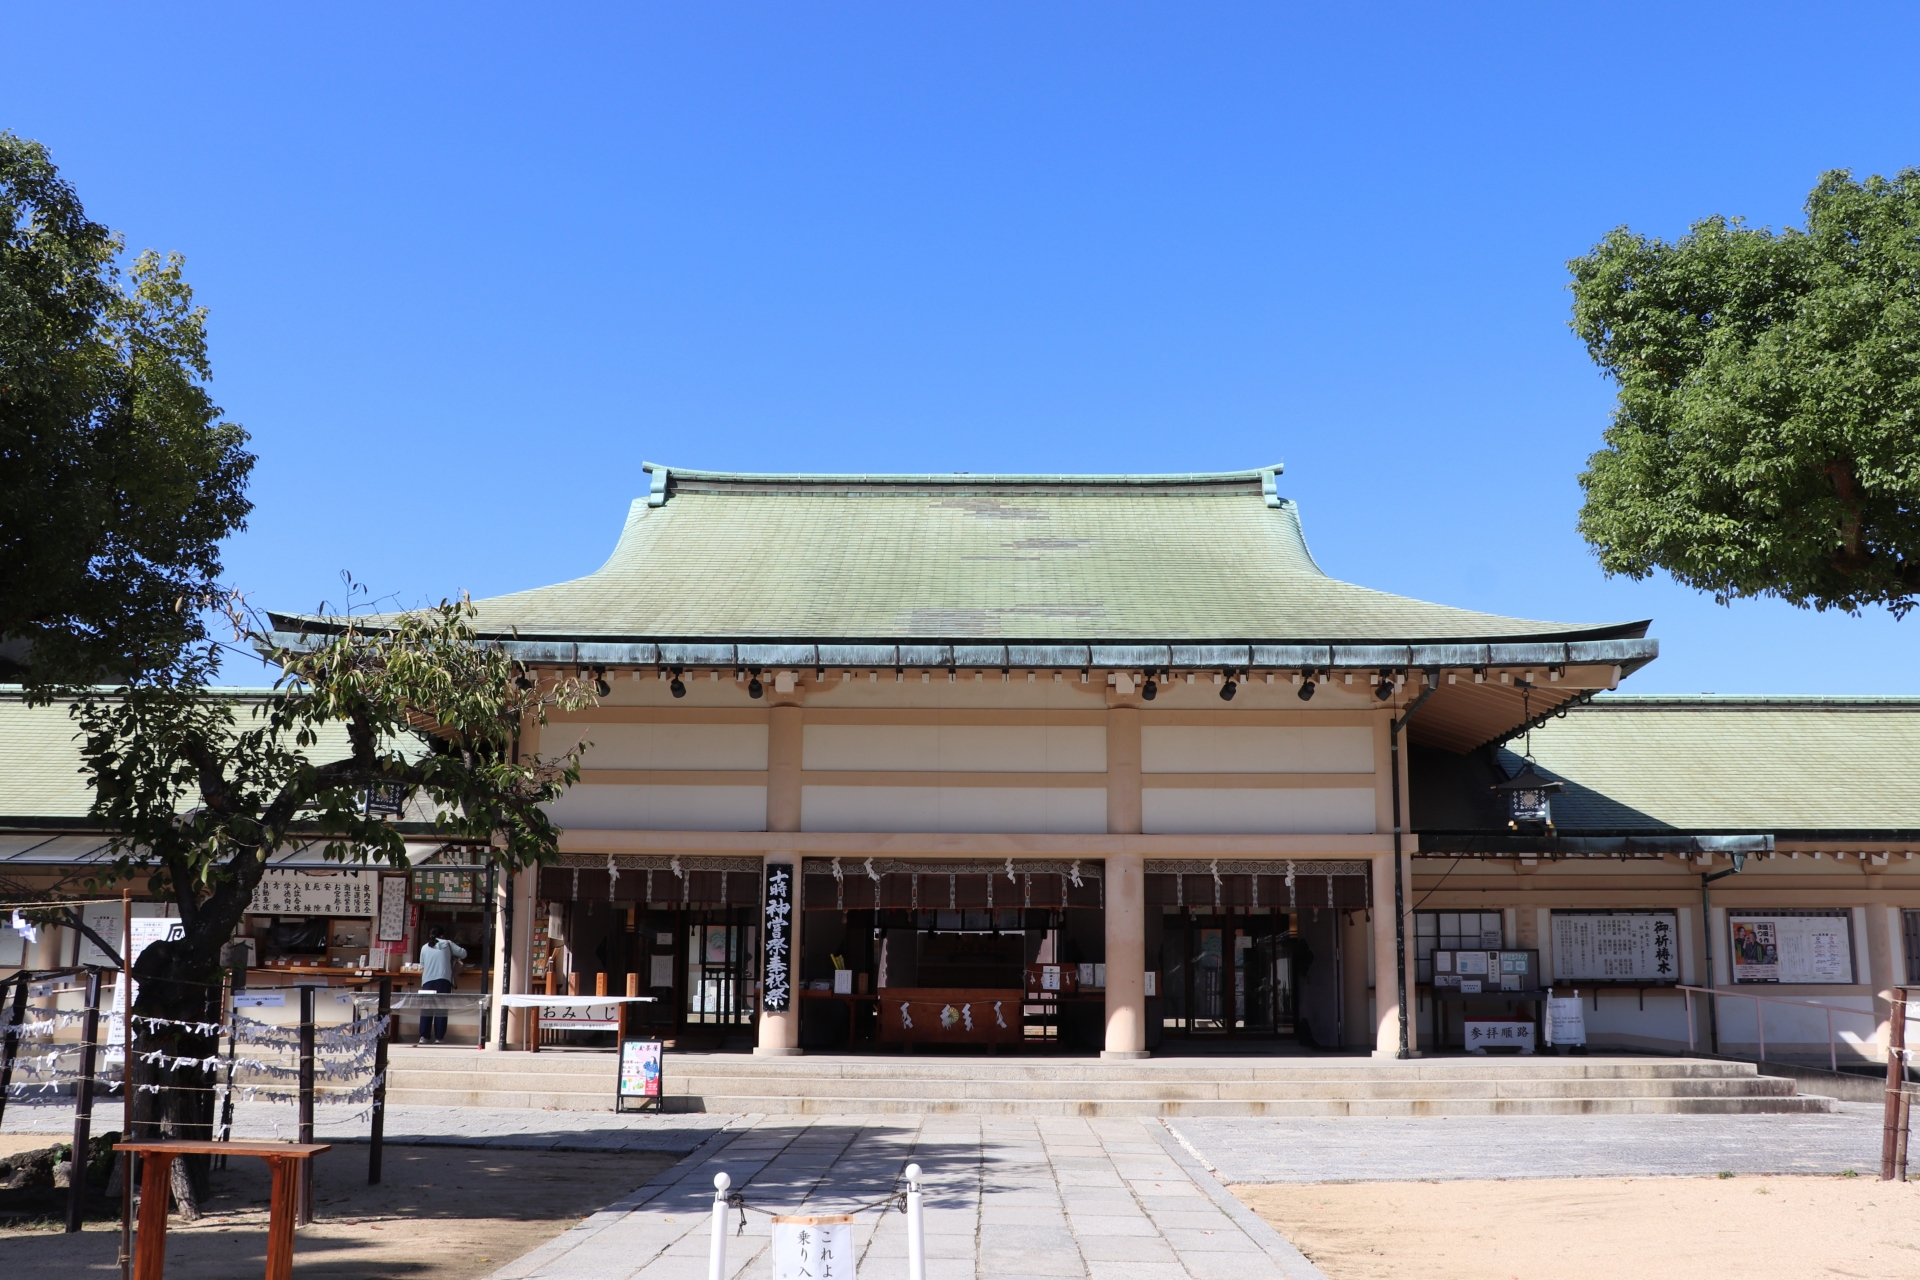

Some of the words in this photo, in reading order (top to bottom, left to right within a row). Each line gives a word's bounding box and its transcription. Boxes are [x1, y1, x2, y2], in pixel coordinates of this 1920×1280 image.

[363, 884, 371, 914] 家内安全
[543, 1005, 615, 1020] おみくじ
[1471, 1026, 1530, 1040] 参拝順路
[797, 1229, 813, 1278] 乗り入
[820, 1231, 834, 1278] これよ
